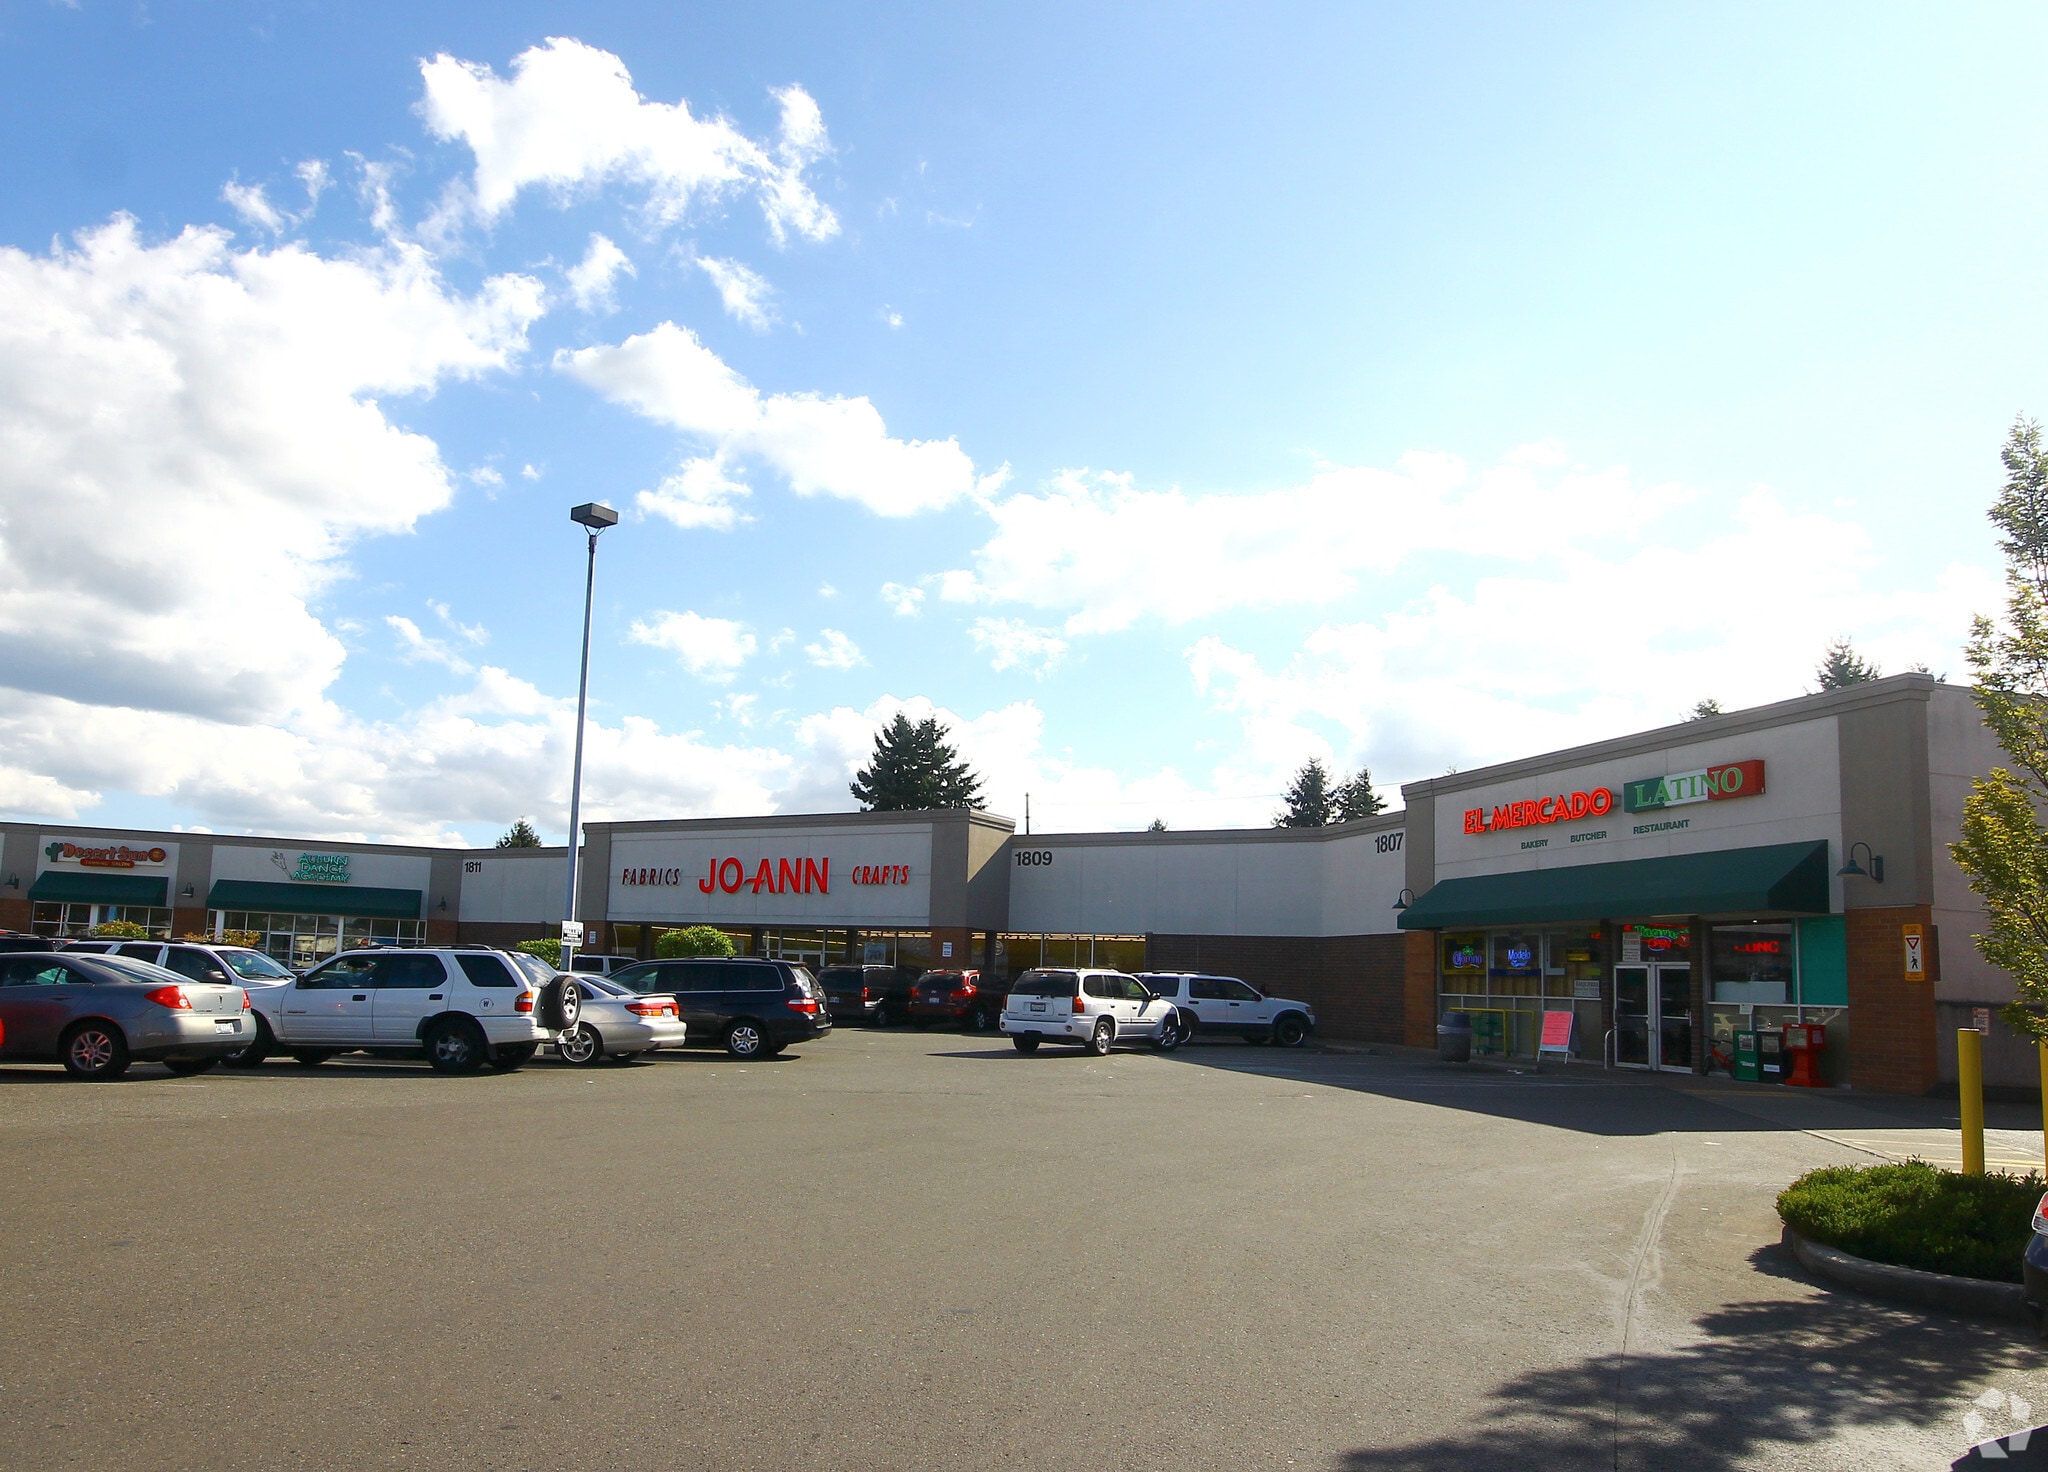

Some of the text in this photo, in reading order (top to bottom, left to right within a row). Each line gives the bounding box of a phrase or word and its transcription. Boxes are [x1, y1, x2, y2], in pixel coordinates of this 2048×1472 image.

[1635, 767, 1743, 808] LATINO
[1463, 787, 1613, 834] EL MERCADO
[1520, 819, 1691, 850] BAKERY BUTCHER RESTAURANT
[1374, 833, 1404, 853] 1807
[63, 843, 149, 861] Desert Sun
[298, 853, 349, 866] AUBURN
[1014, 851, 1053, 866] 1809
[301, 862, 344, 874] DANCE
[464, 861, 482, 873] 1811
[292, 871, 351, 883] ACADEMY
[622, 868, 681, 886] FABRICS
[852, 865, 912, 886] CRAFTS
[1507, 949, 1532, 962] Modelo
